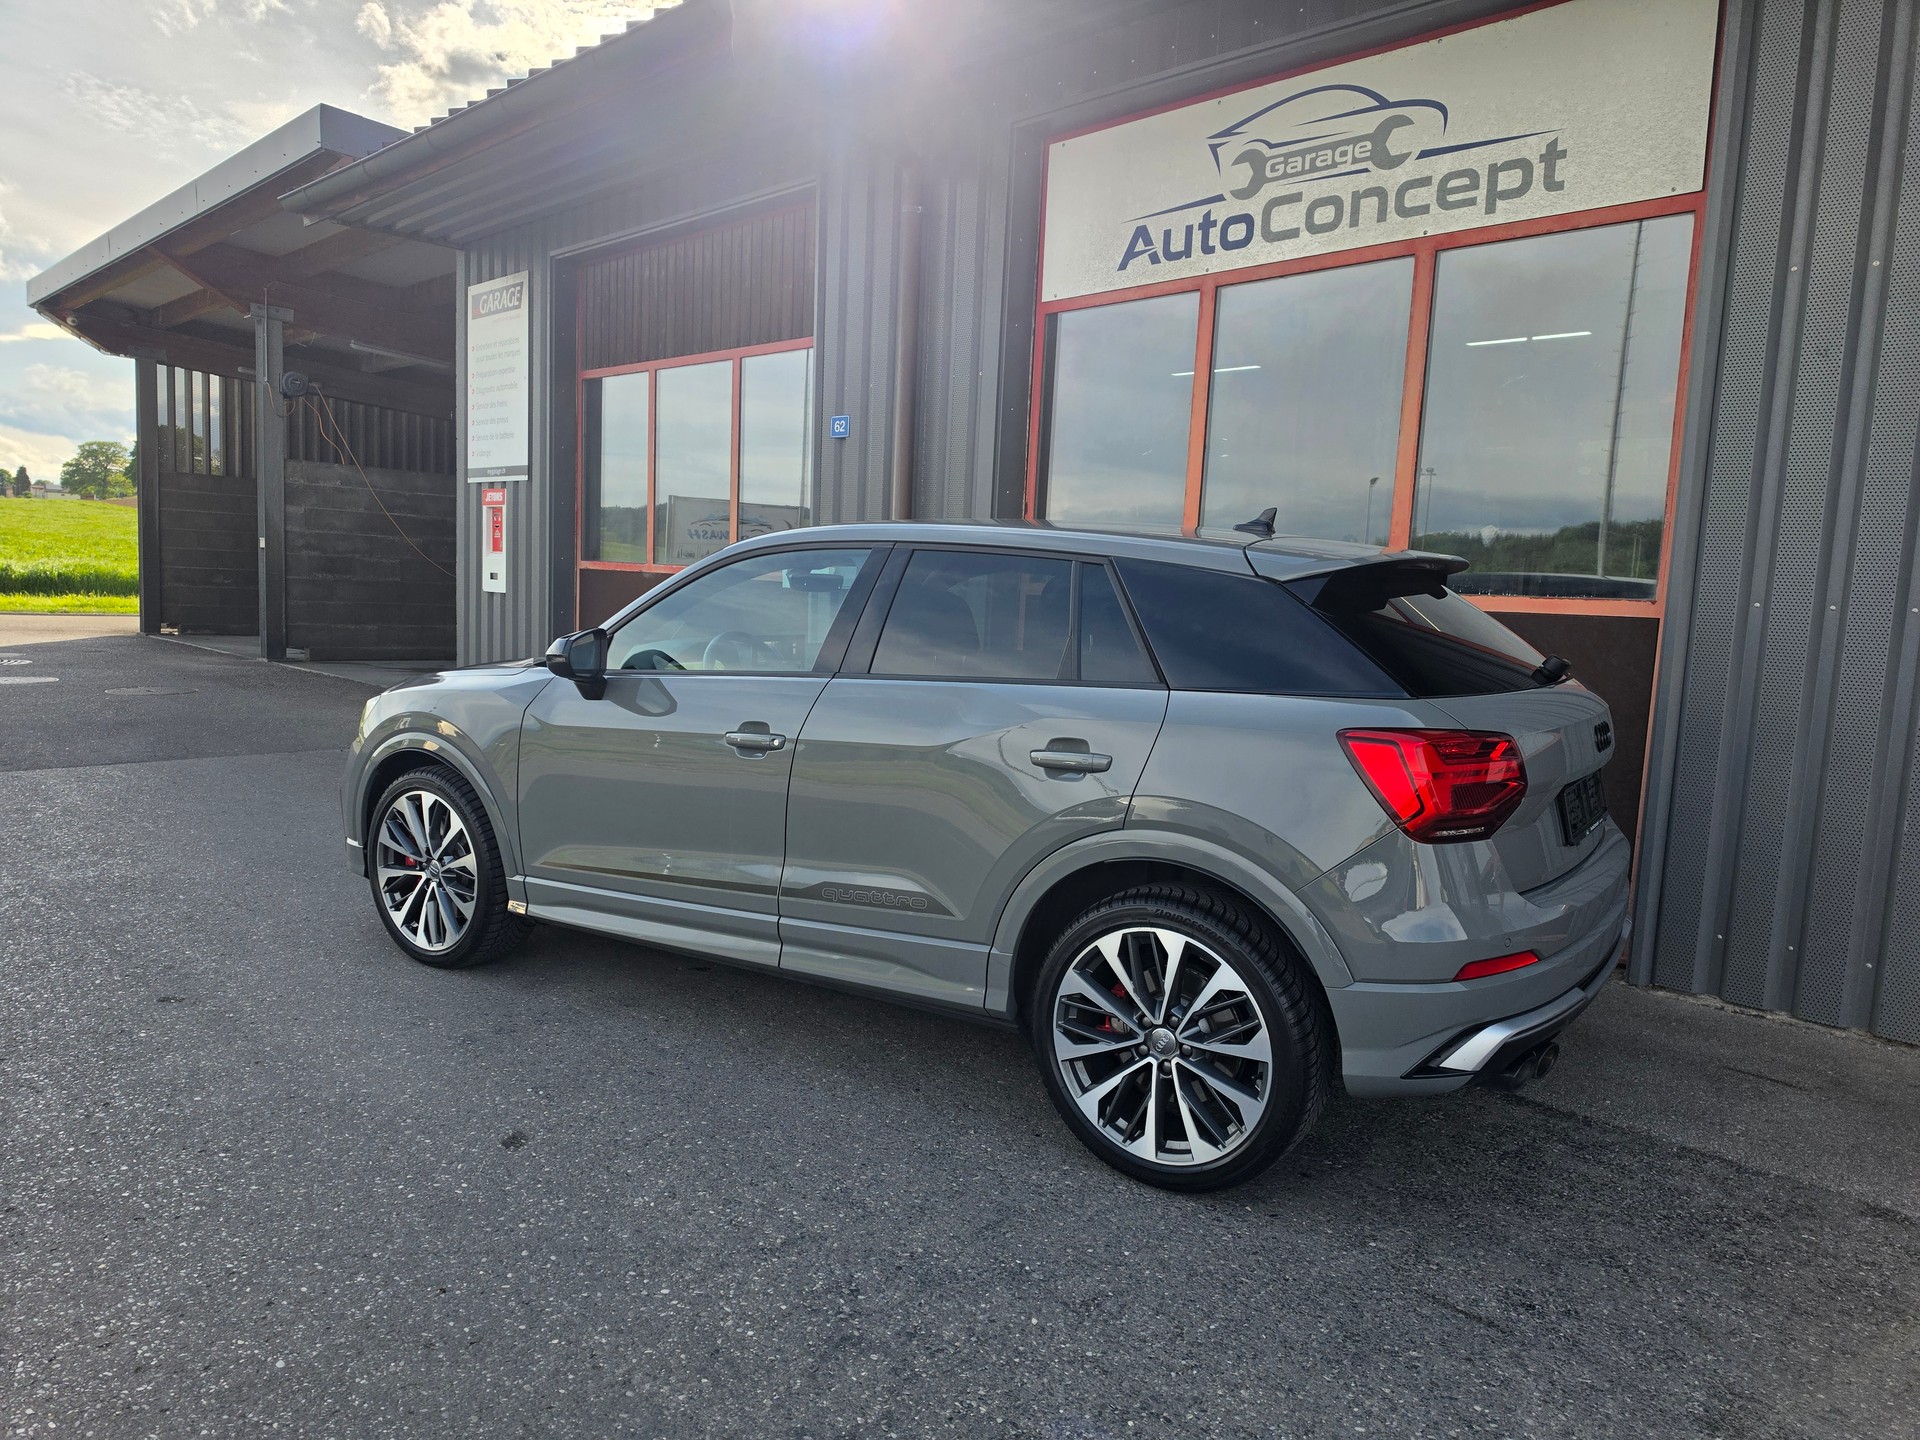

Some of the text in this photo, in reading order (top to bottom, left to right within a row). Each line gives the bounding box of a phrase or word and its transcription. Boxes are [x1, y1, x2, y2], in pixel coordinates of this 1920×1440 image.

[1264, 140, 1372, 178] Garage
[480, 286, 520, 314] GARAGE
[834, 420, 846, 432] 62
[822, 888, 928, 909] quattro
